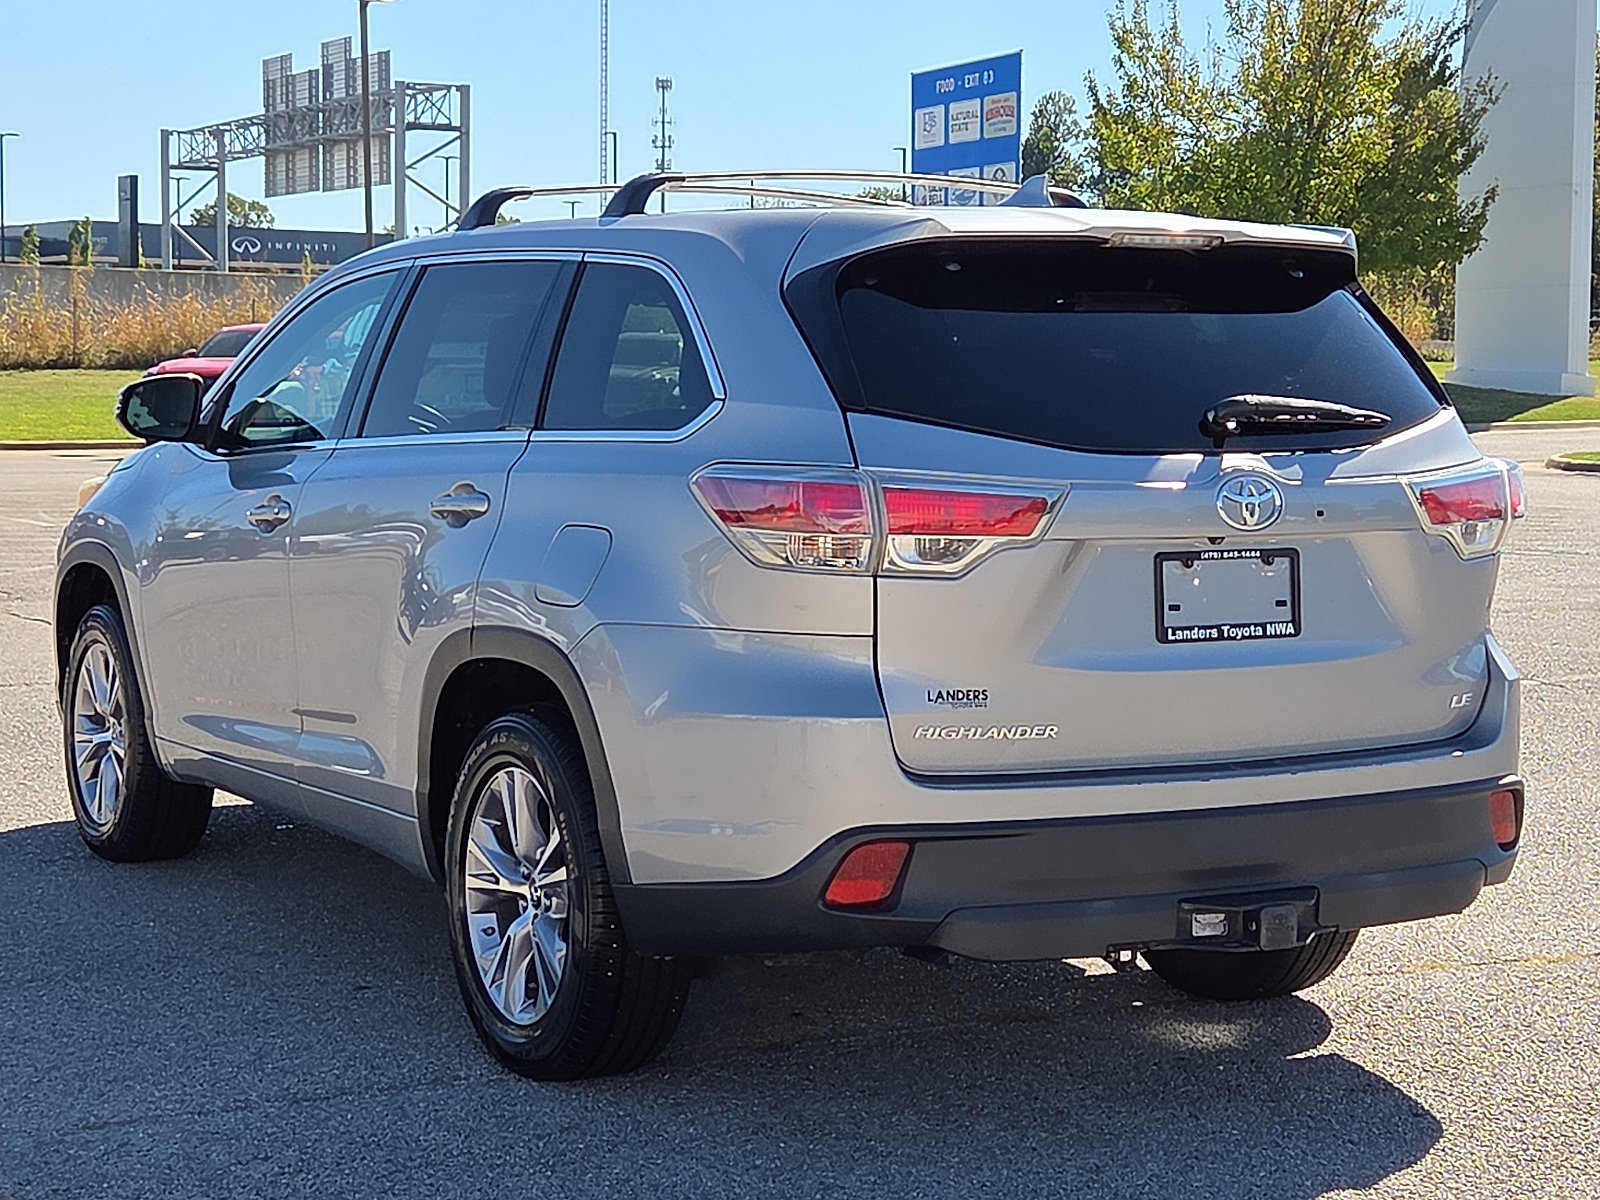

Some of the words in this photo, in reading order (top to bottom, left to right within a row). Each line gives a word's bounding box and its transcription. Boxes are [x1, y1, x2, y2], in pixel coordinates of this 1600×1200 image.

[936, 78, 955, 93] FOOD
[964, 73, 980, 88] EXIT
[951, 110, 979, 122] NATURAL
[951, 122, 969, 133] STATE
[268, 241, 336, 252] INFINITI
[1167, 627, 1218, 641] Landers
[1221, 625, 1263, 640] Toyota
[1266, 622, 1295, 636] NWA
[927, 689, 989, 704] LANDERS
[1450, 693, 1473, 709] LE
[913, 725, 1058, 740] HIGHLANDER
